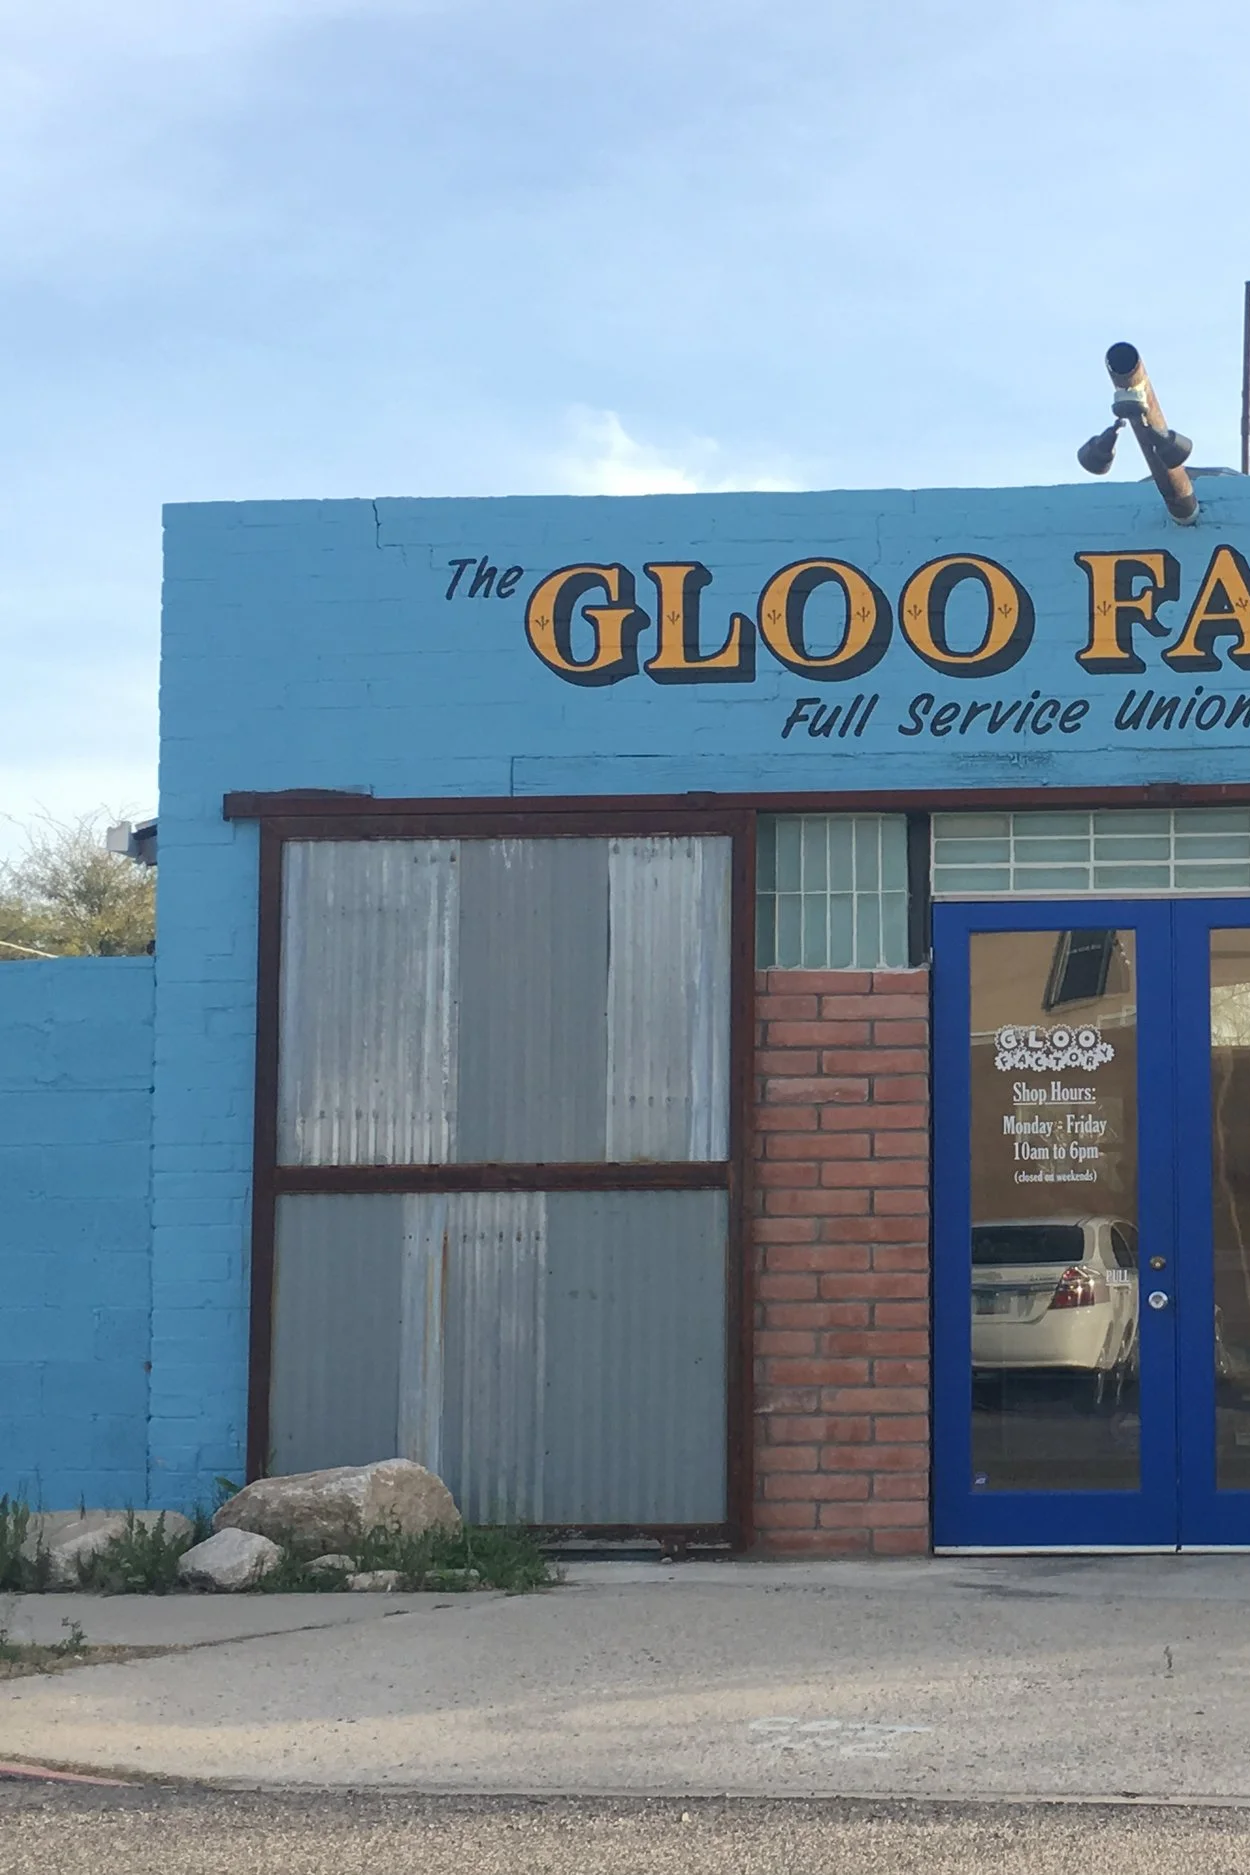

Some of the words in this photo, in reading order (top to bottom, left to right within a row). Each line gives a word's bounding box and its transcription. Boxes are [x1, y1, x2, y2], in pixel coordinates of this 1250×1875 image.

[446, 555, 525, 601] The
[524, 552, 1036, 687] GLOO
[780, 693, 880, 739] Full
[898, 690, 1090, 737] Service
[998, 1027, 1098, 1051] GLOO
[999, 1046, 1111, 1068] FACTORY
[1013, 1082, 1047, 1105] Shop
[1051, 1081, 1097, 1102] Hours:
[1003, 1115, 1054, 1137] Monday
[1066, 1114, 1108, 1136] Friday
[1014, 1141, 1050, 1161] 10am
[1053, 1143, 1066, 1160] to
[1070, 1140, 1100, 1163] 6pm
[1105, 1269, 1130, 1283] PULL
